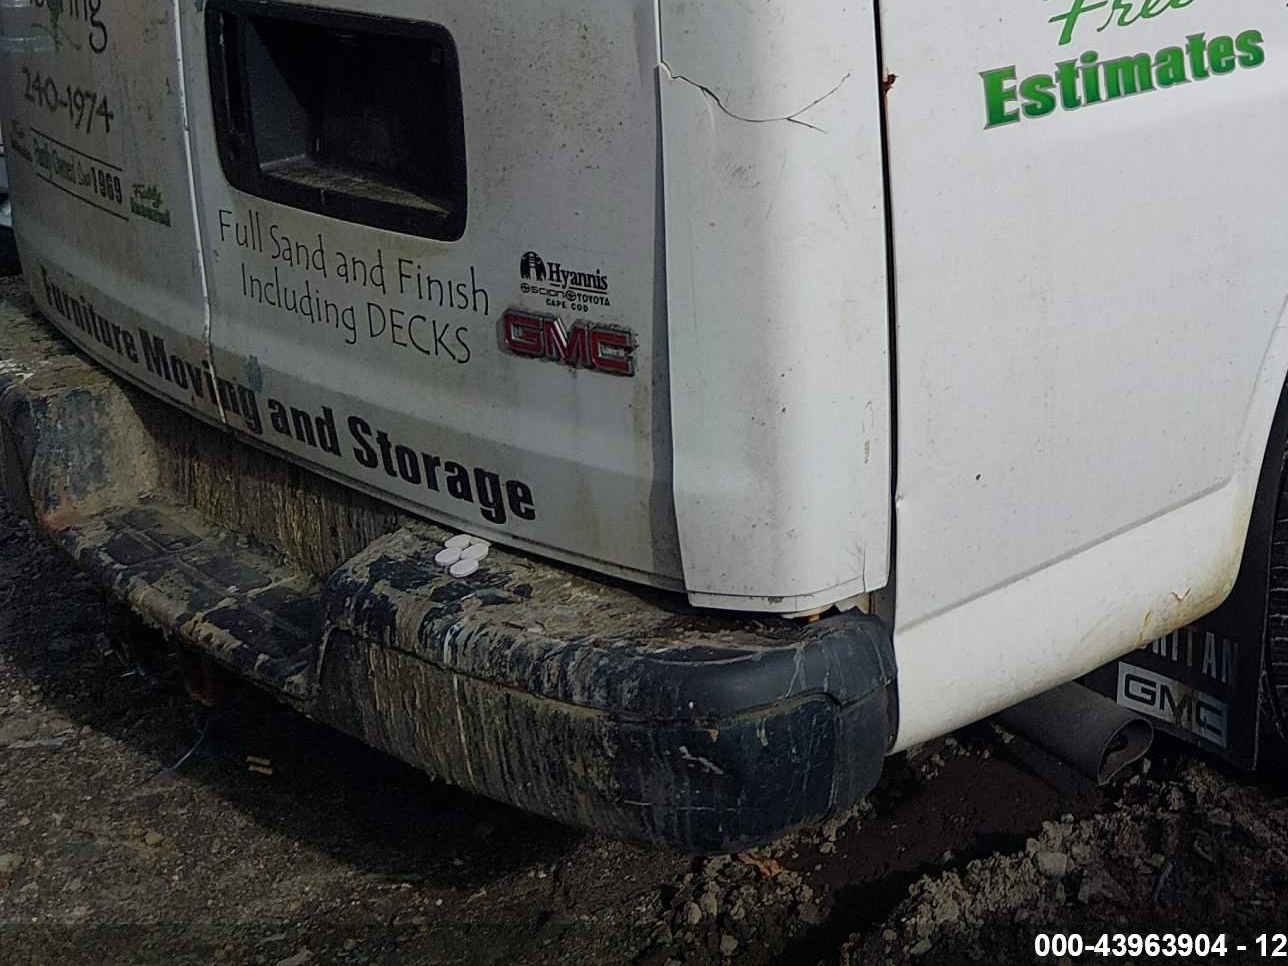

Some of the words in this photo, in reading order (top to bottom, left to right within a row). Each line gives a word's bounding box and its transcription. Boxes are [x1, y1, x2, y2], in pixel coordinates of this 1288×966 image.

[22, 67, 115, 134] 240-1974
[979, 28, 1265, 130] Estimates
[91, 167, 123, 205] 1969
[218, 209, 263, 253] Full
[270, 224, 327, 278] Sand
[336, 249, 386, 294] and
[398, 258, 489, 315] Finish
[547, 262, 609, 291] Hyannis
[241, 263, 357, 345] Including
[367, 302, 471, 364] DECKS
[546, 298, 567, 309] CAPE
[571, 303, 589, 312] COD
[577, 293, 611, 307] TOYOTA
[499, 308, 637, 377] GMC
[139, 327, 263, 434] Moving
[269, 397, 341, 457] and
[349, 416, 537, 524] Storage
[1124, 673, 1224, 738] GMC
